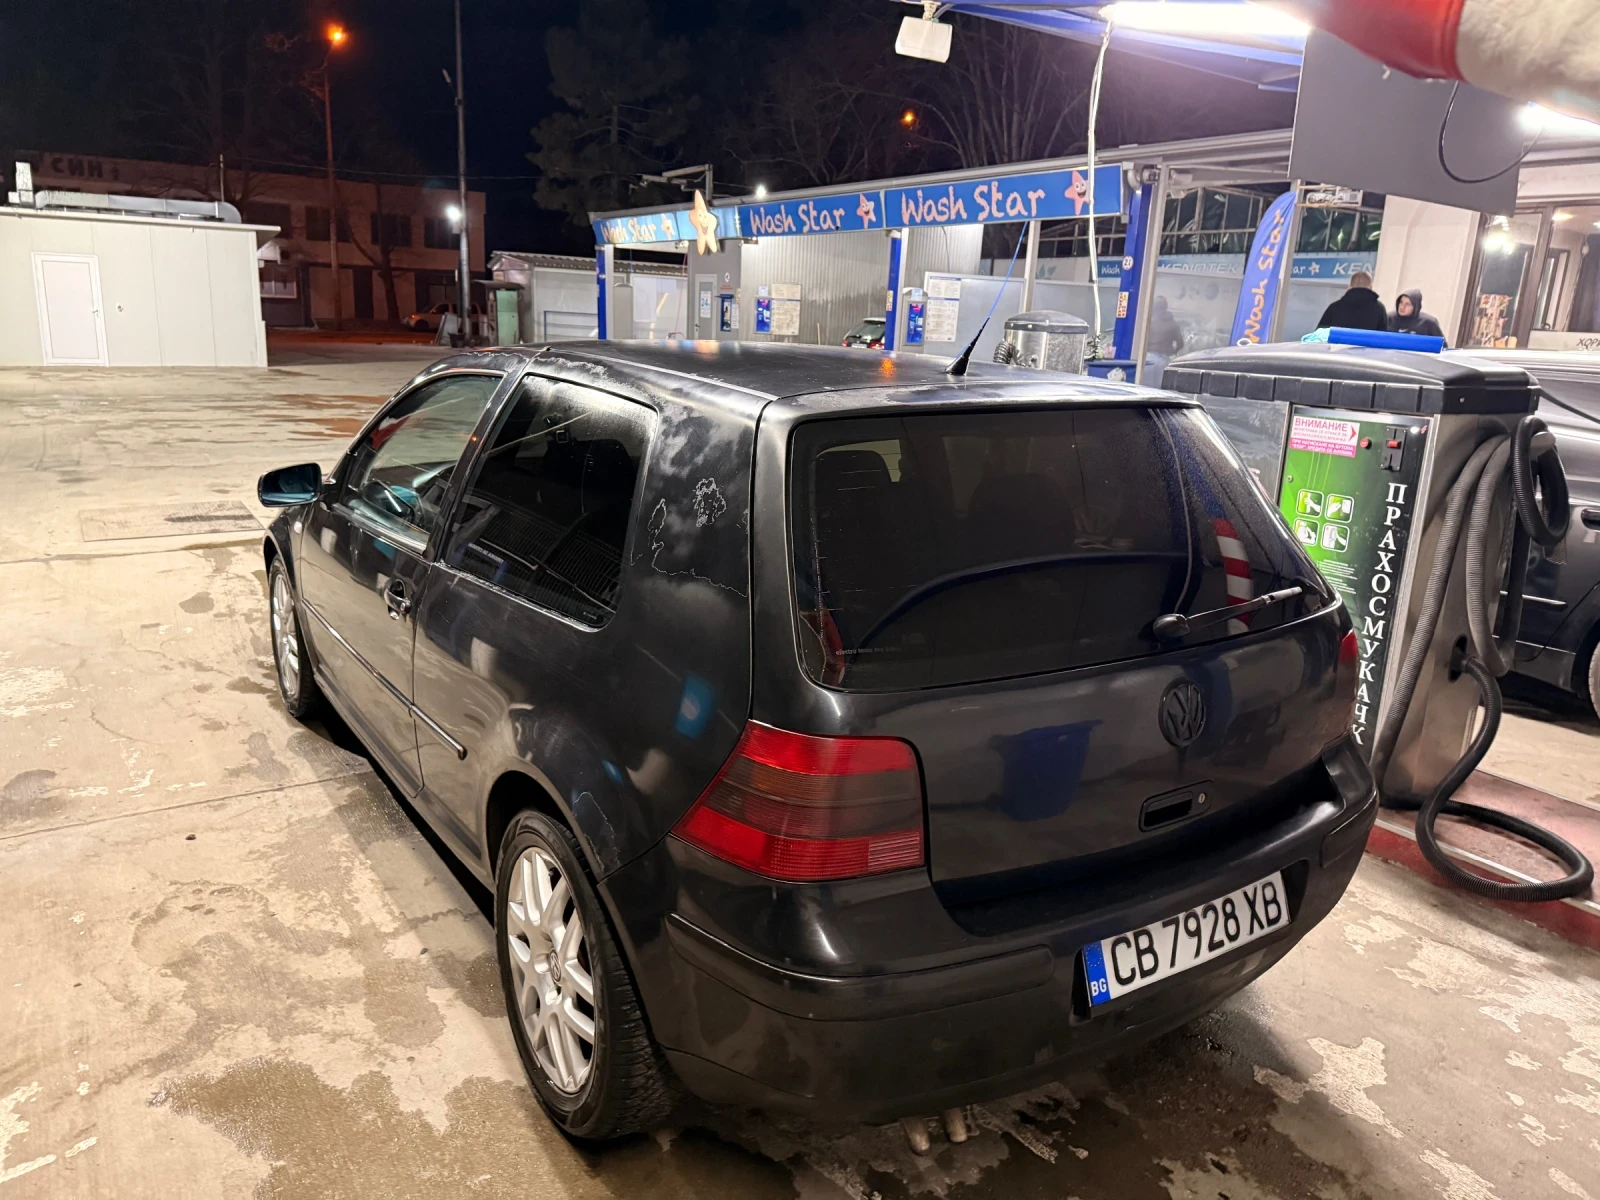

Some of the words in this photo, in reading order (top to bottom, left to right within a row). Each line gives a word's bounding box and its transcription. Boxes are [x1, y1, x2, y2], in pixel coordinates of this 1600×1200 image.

[750, 204, 796, 235] Wash
[798, 201, 845, 233] Star
[901, 185, 967, 225] Wash
[974, 180, 1046, 221] Star
[600, 218, 629, 243] Wash
[628, 215, 656, 242] Star
[1101, 264, 1120, 275] Wash
[1243, 279, 1268, 344] Wash
[1257, 209, 1285, 271] Star
[1294, 417, 1349, 432] ВНИМАНИЕ
[1351, 482, 1408, 745] ПРАХОСМУКАЧК
[1110, 927, 1160, 987] CB
[1162, 897, 1241, 969] 7928
[1242, 881, 1282, 936] XB
[1090, 977, 1108, 997] BG
